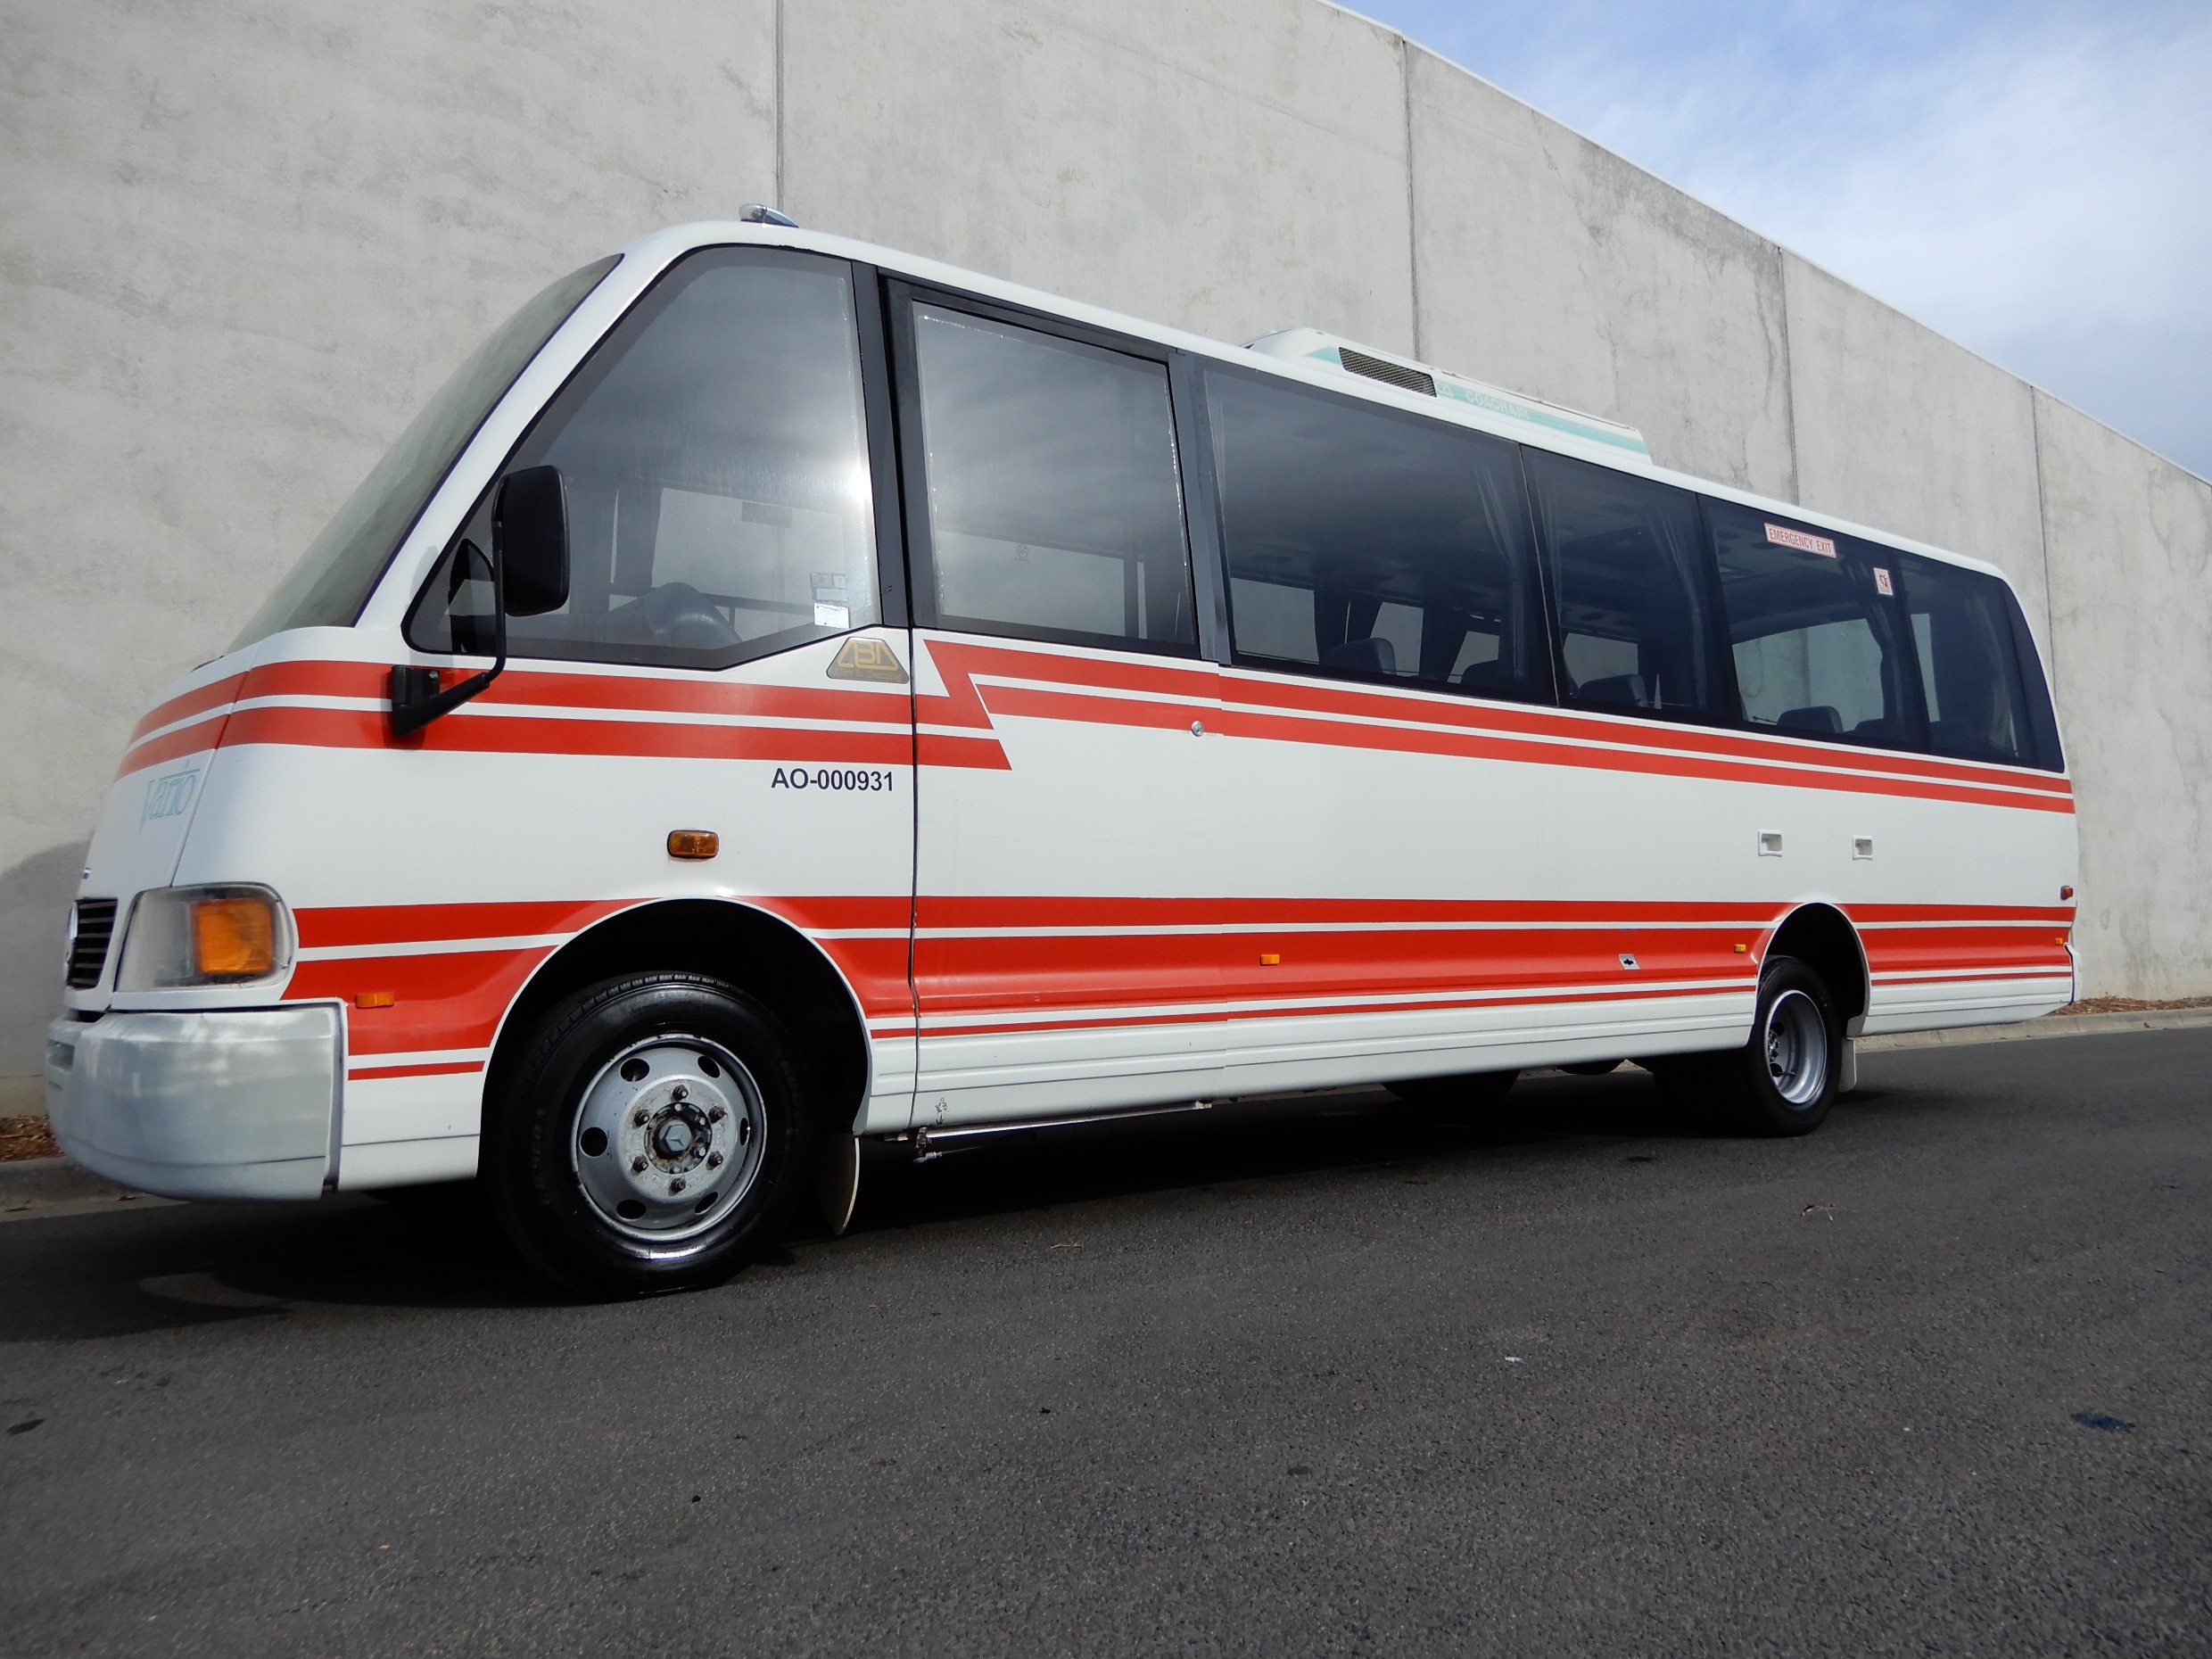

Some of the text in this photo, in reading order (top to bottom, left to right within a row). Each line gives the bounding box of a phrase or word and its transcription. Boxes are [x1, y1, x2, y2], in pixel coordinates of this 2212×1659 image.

[1465, 389, 1529, 421] COACHAIR
[1769, 528, 1832, 554] EMERGENCY EXIT
[771, 767, 893, 792] AO-000931
[139, 763, 202, 833] Vario
